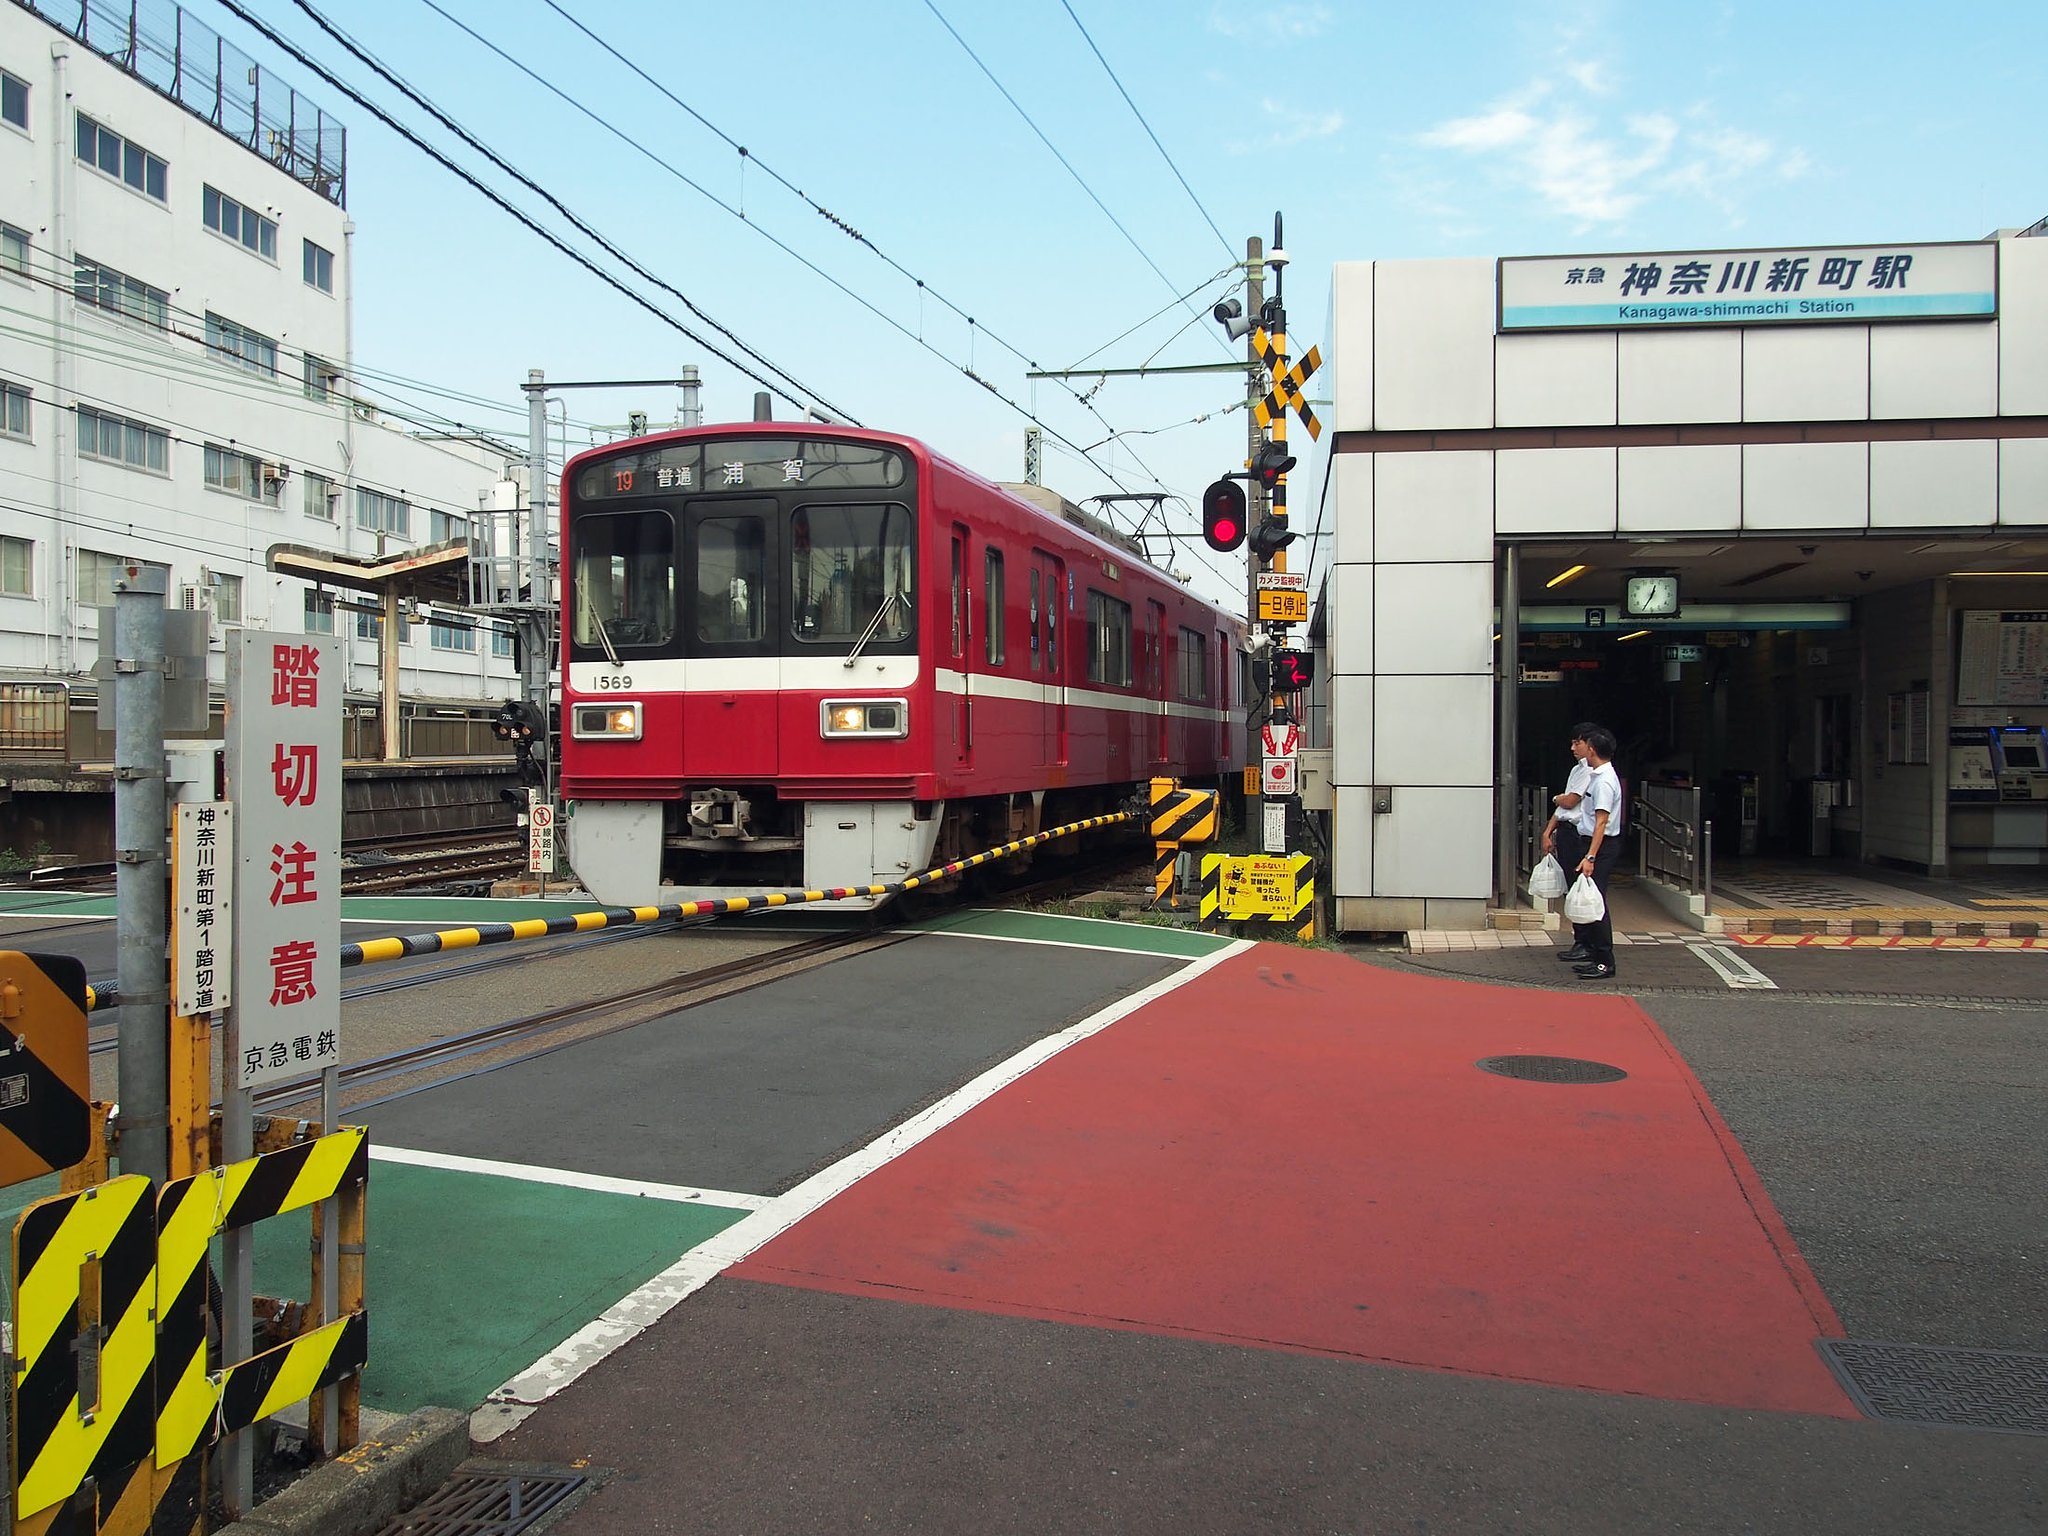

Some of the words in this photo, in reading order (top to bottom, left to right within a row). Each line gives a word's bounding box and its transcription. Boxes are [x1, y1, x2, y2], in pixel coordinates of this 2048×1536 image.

[1564, 266, 1606, 285] 京急
[1618, 254, 1914, 297] 神奈川新町駅
[1619, 300, 1789, 320] Kanagawa-shimmachi
[1799, 298, 1855, 314] Station
[616, 470, 633, 491] 19
[657, 465, 692, 487] 普通
[722, 459, 804, 485] 浦賀
[1259, 576, 1302, 585] カメラ監視中
[1260, 596, 1305, 615] 一旦停止
[592, 676, 633, 690] 1569
[268, 644, 321, 1008] 踏切注意
[531, 828, 541, 870] 立入禁止
[542, 828, 552, 860] 線路内
[195, 807, 216, 1009] 神奈川新町第1踏切道
[243, 1029, 337, 1075] 京急電鉄
